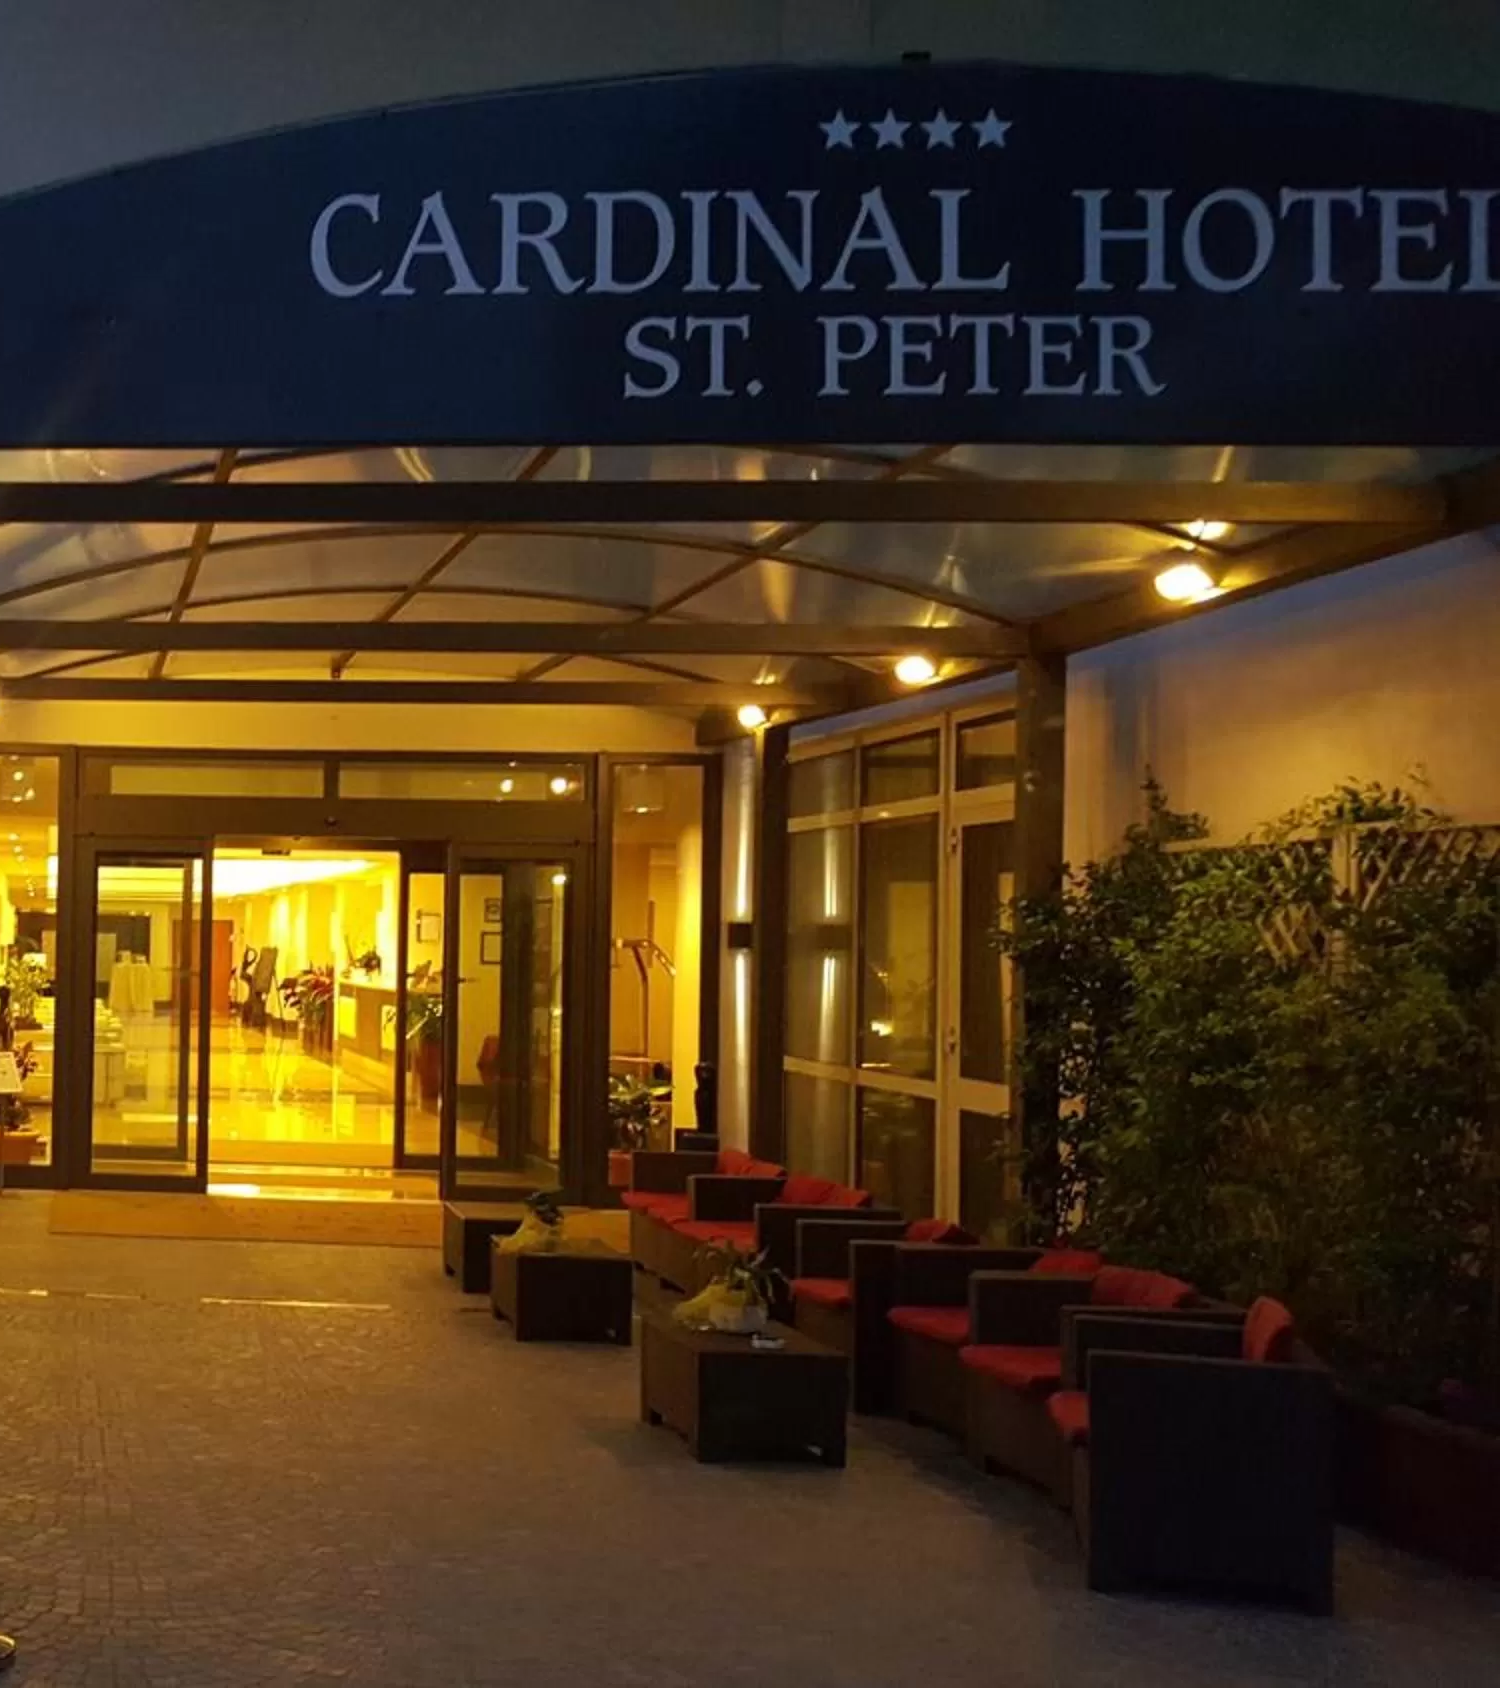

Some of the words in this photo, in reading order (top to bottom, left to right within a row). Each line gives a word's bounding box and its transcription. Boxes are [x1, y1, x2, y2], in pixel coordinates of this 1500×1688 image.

[310, 187, 1011, 297] CARDINAL
[623, 315, 764, 398] ST.
[816, 313, 1167, 397] PETER
